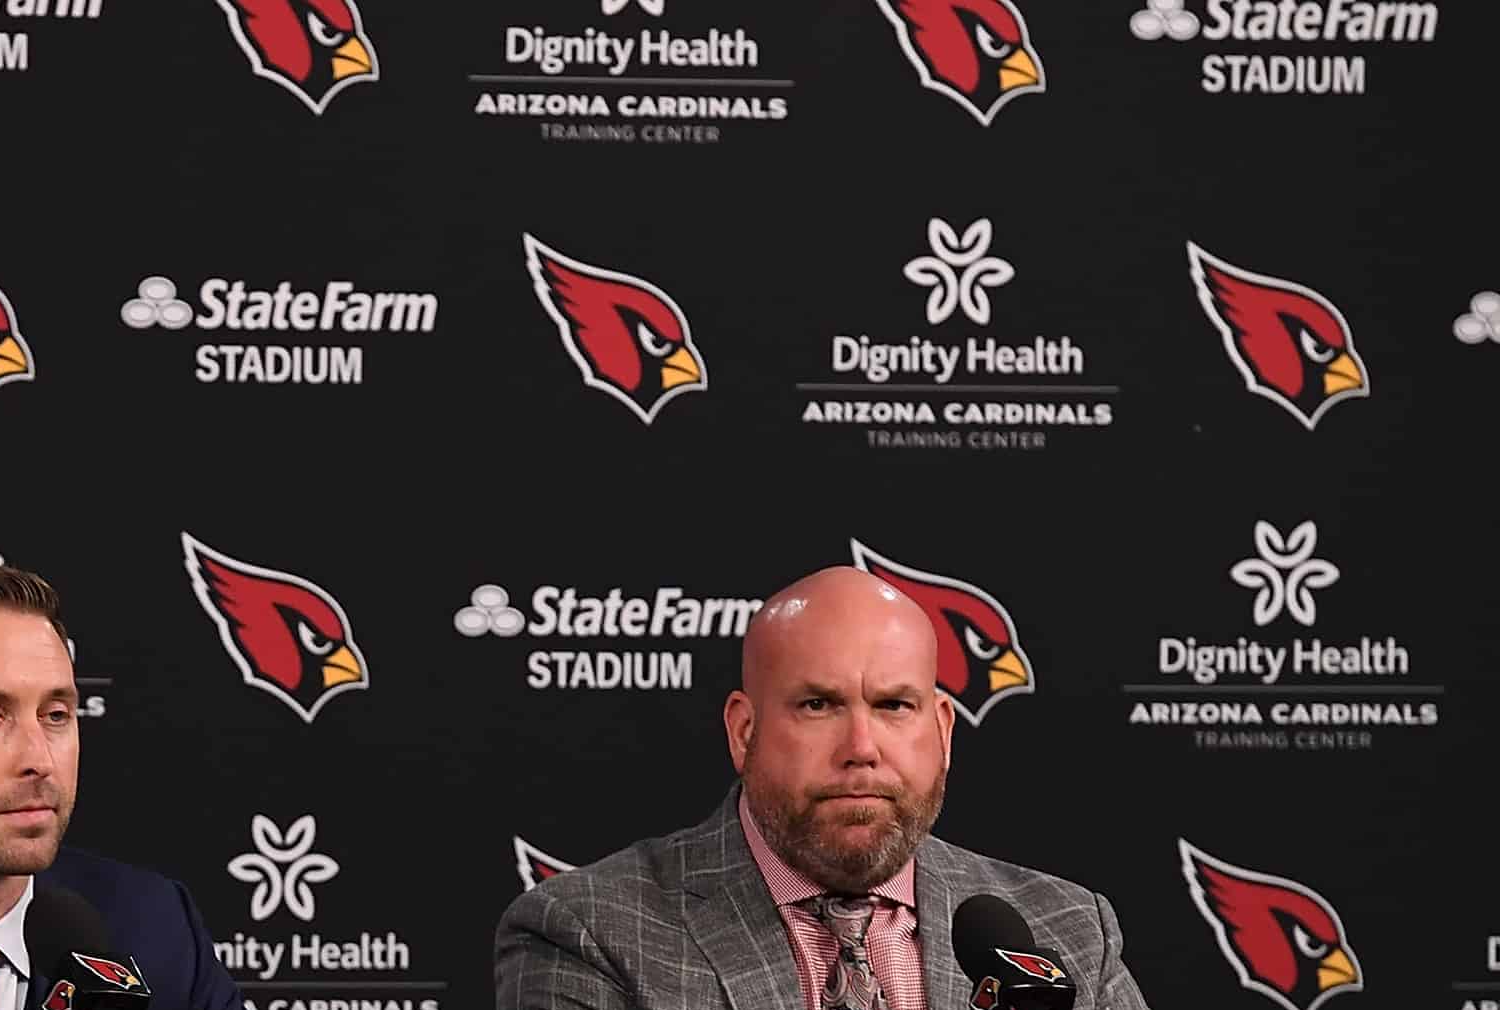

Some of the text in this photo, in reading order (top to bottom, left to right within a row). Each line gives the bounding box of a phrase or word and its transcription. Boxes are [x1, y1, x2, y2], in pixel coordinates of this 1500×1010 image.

[505, 26, 758, 74] Dignity Health
[1201, 54, 1365, 94] STADIUM
[475, 93, 788, 119] ARIZONA CARDINALS
[540, 122, 720, 143] TRAINING CENTER
[195, 344, 363, 384] STADIUM
[832, 335, 1083, 384] Dignity Health
[802, 401, 1113, 425] ARIZONA CARDINALS
[867, 430, 1046, 449] TRAINING CENTER
[527, 651, 693, 689] STADIUM
[1159, 637, 1409, 684] Dignity Health
[1129, 702, 1438, 725] ARIZONA CARDINALS
[1195, 730, 1371, 748] TRAINING CENTER
[213, 932, 409, 980] nity Health
